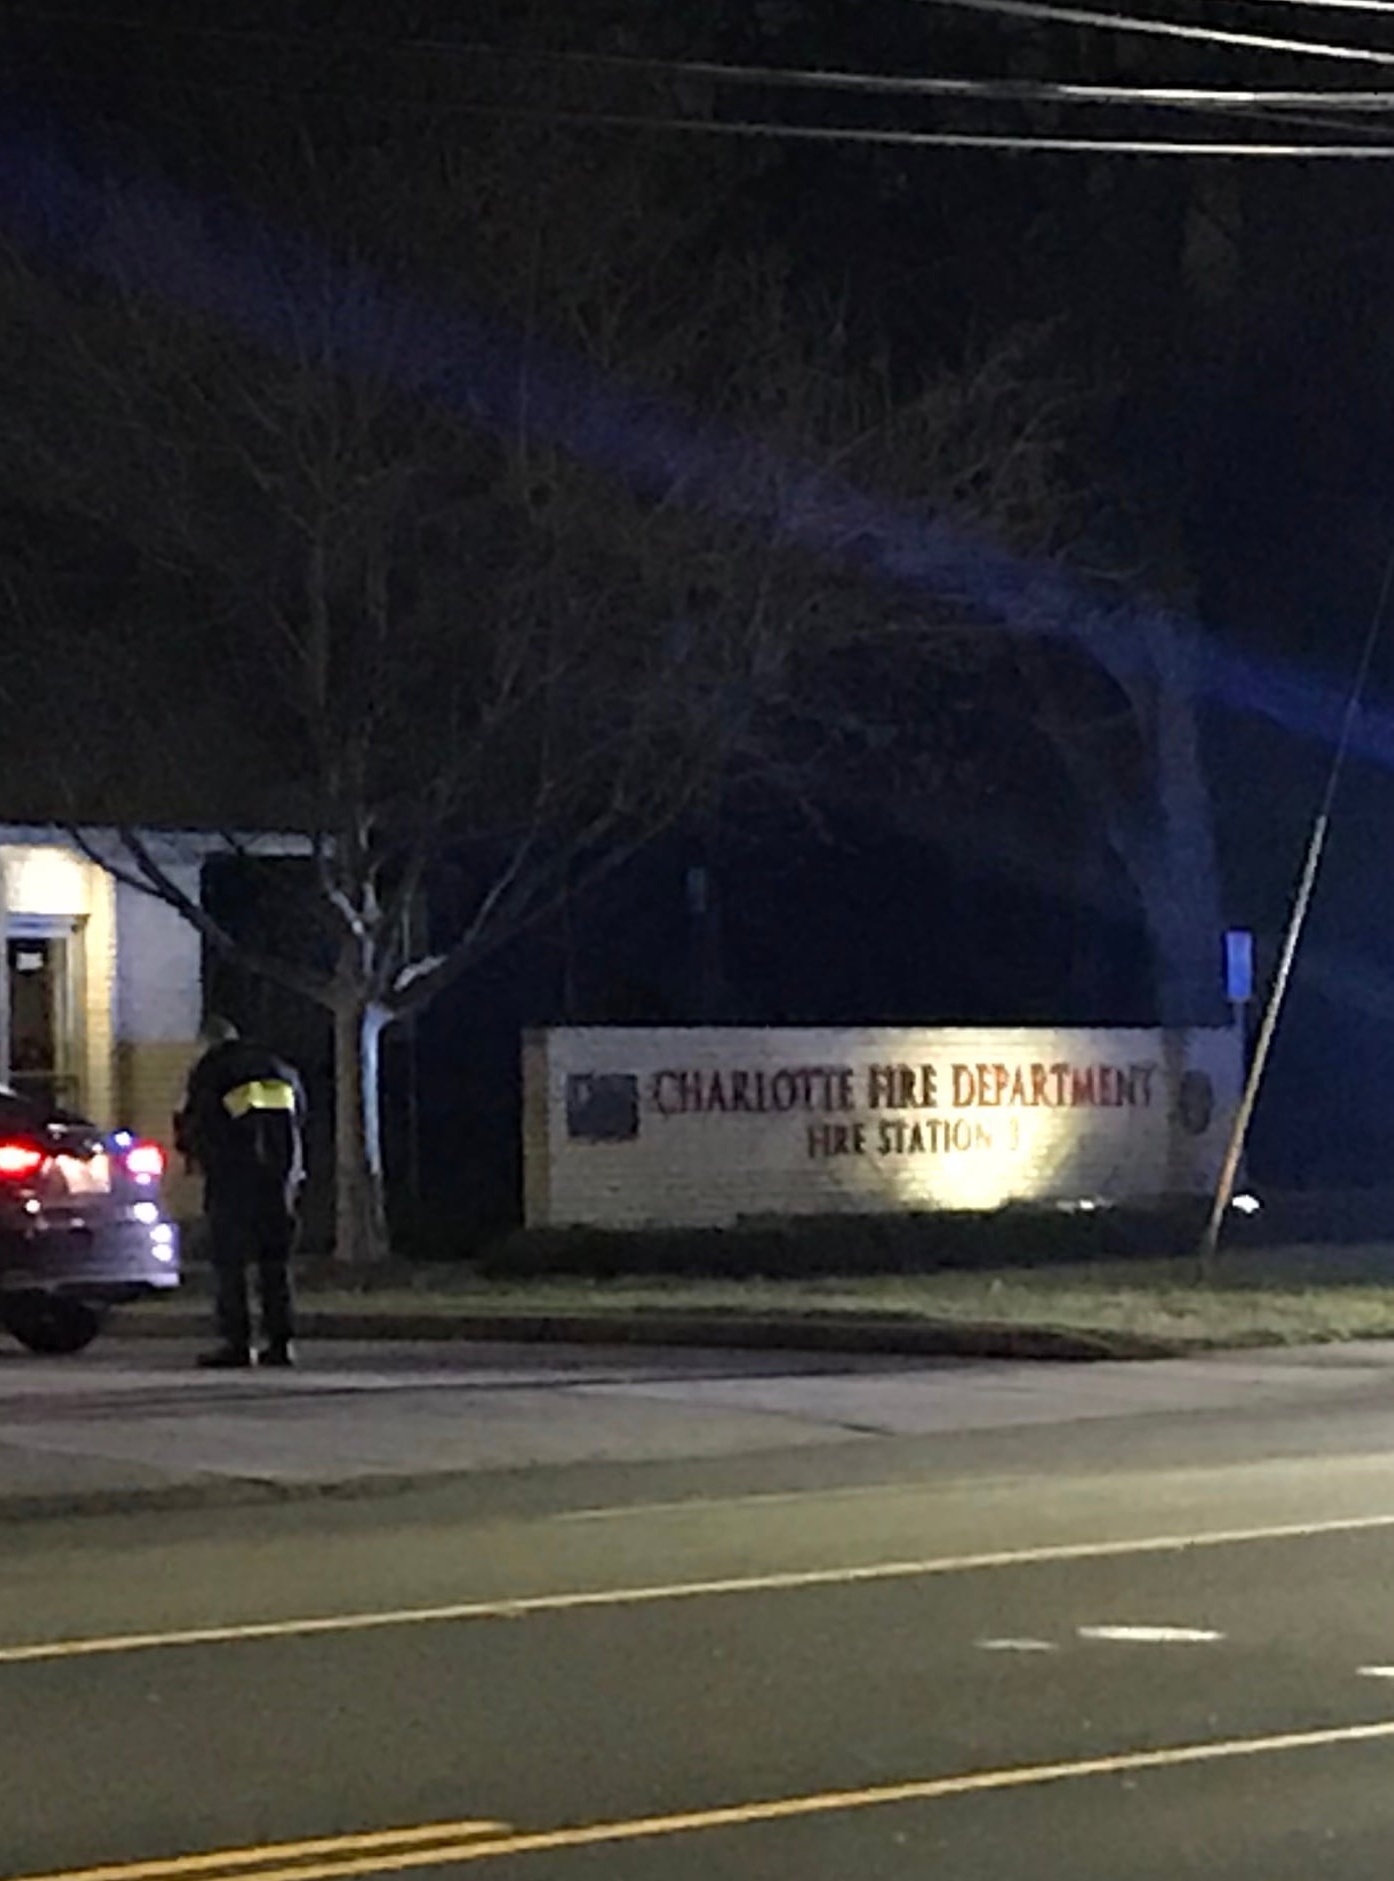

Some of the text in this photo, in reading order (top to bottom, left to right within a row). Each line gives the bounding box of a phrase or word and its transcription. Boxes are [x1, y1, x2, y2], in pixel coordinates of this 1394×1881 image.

[653, 1061, 1156, 1114] CHARLOTTE FIRE DEPARTMENT
[808, 1121, 865, 1158] FIRE
[878, 1117, 993, 1155] STATION
